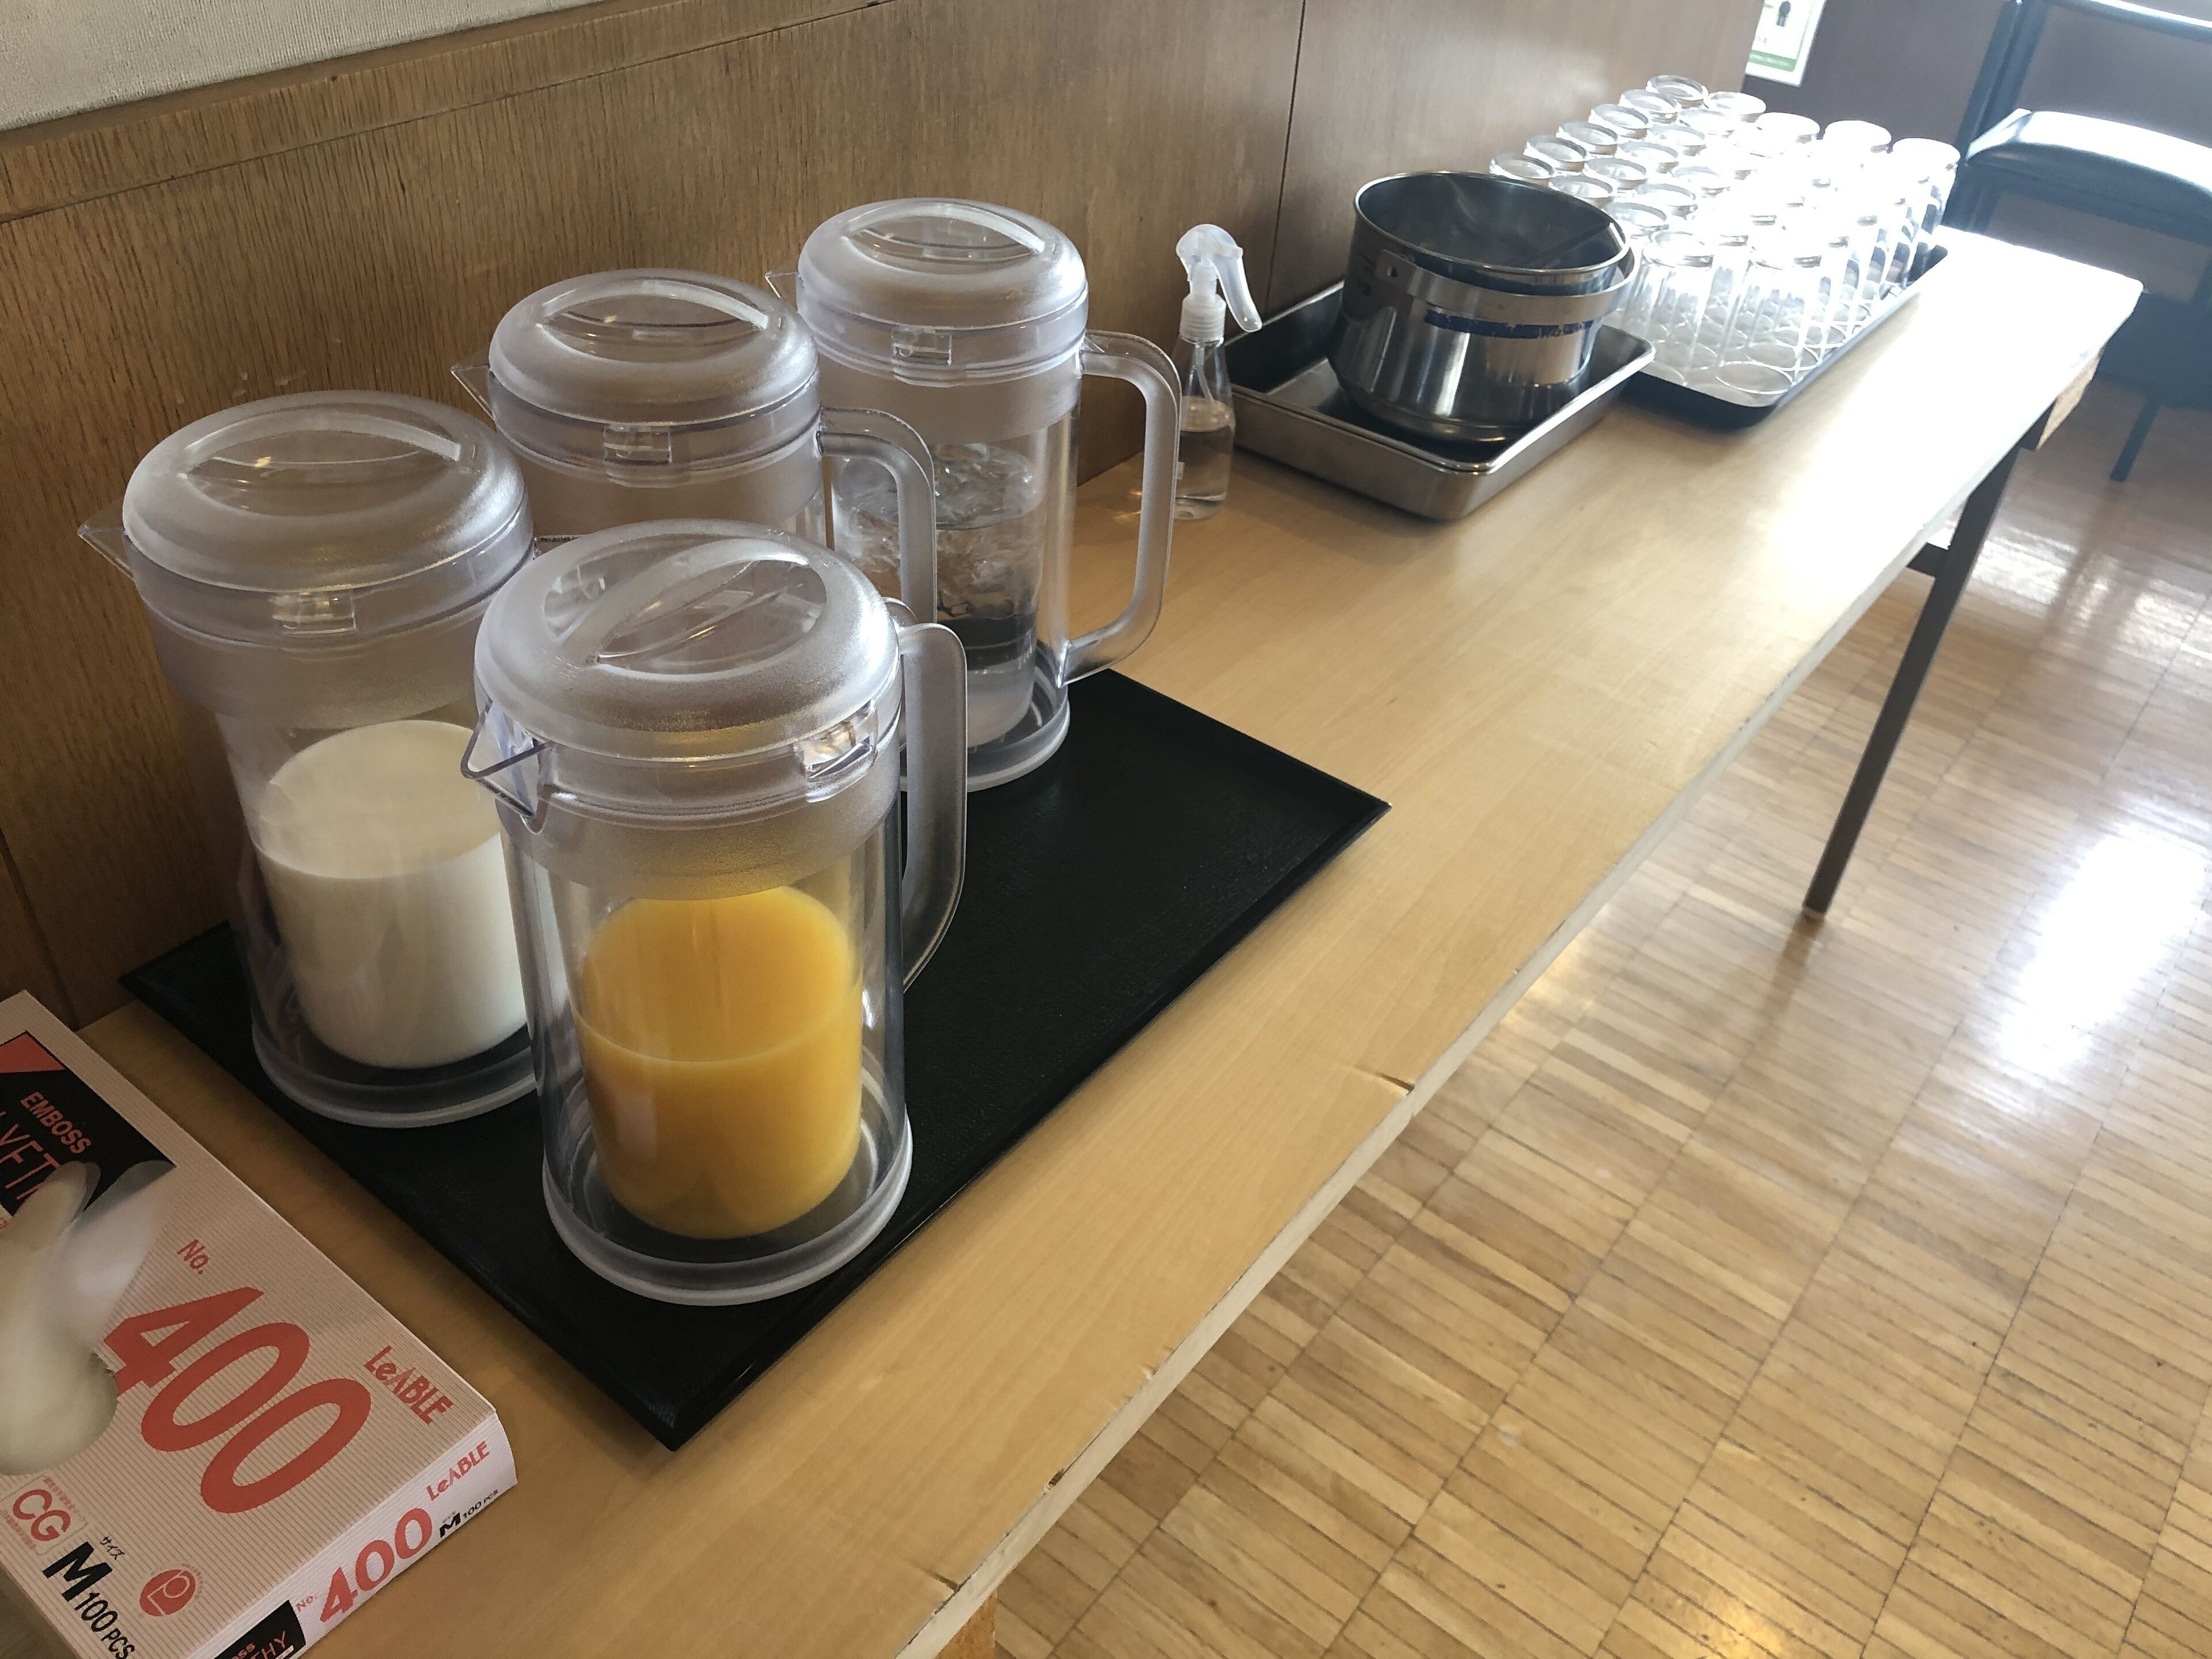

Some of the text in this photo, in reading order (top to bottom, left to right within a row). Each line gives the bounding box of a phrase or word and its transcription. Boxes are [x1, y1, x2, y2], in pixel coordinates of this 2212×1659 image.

[21, 1092, 92, 1153] EMBOSS
[176, 1238, 210, 1275] No.
[104, 1286, 372, 1514] 400
[13, 1489, 70, 1541] CG
[440, 1512, 461, 1538] M
[462, 1501, 482, 1519] 100
[100, 1536, 125, 1560] サイズ
[319, 1508, 433, 1623] 400
[43, 1541, 113, 1602] M
[74, 1592, 118, 1632] 100
[101, 1628, 135, 1659] PCS
